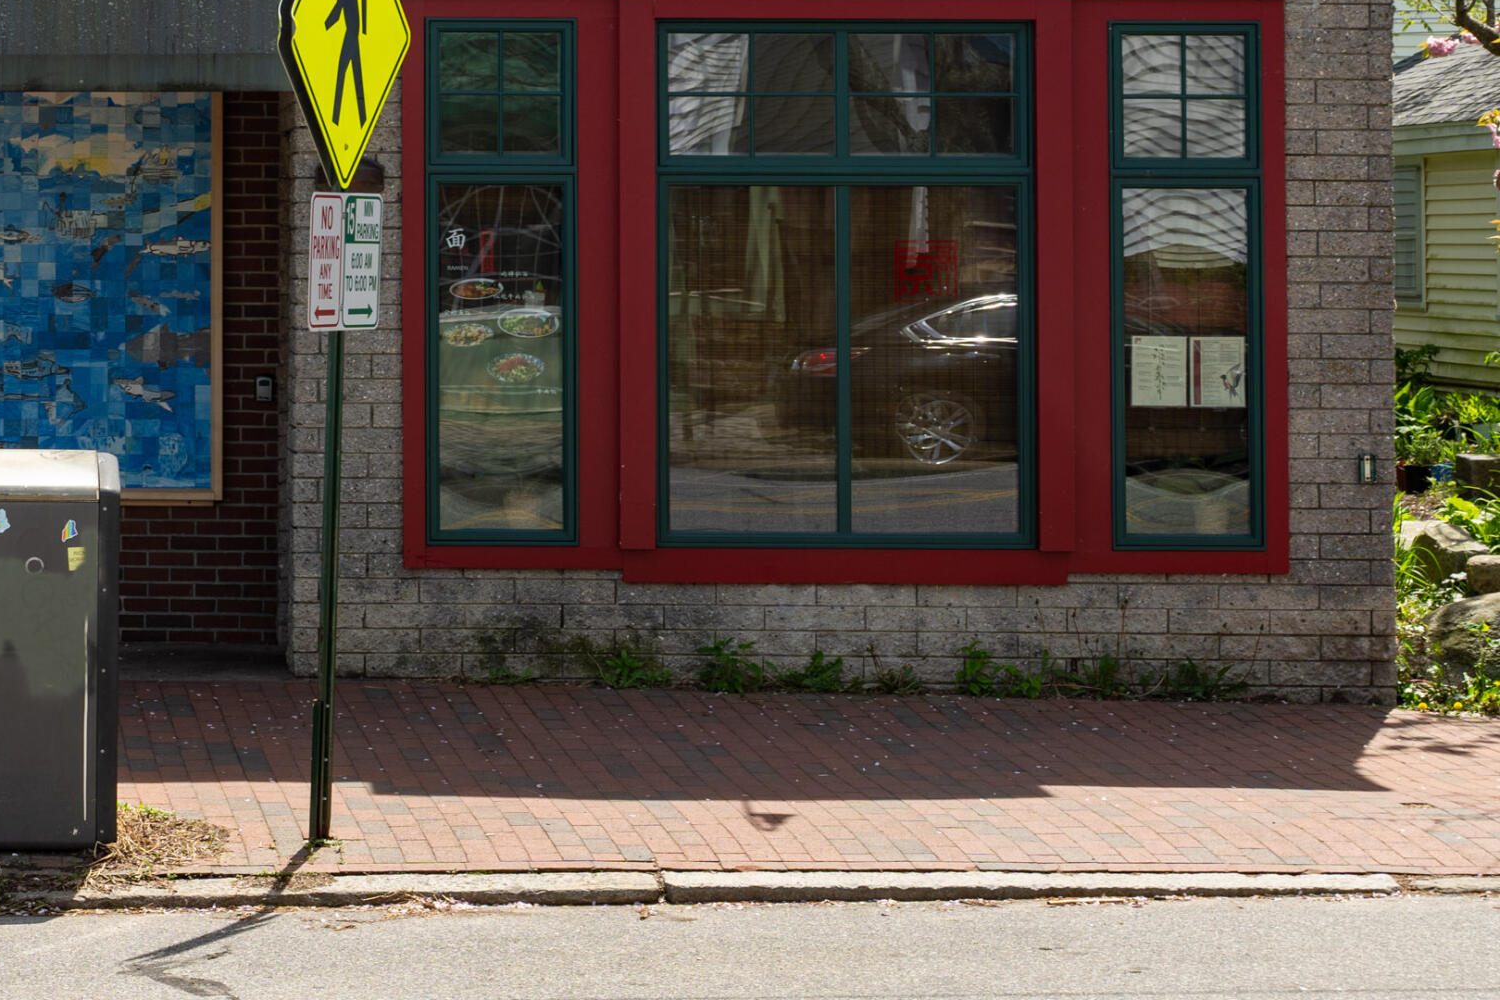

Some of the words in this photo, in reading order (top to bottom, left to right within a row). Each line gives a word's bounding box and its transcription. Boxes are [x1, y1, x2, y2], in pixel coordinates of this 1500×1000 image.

[321, 205, 333, 230] NO
[364, 201, 374, 217] MIN
[346, 202, 355, 235] 15
[357, 223, 379, 240] PARKING
[446, 228, 466, 249] 面
[313, 235, 340, 260] PARKING
[351, 253, 363, 269] 6:00
[364, 253, 372, 268] AM
[319, 263, 333, 280] ANY
[318, 283, 332, 300] TIME
[346, 275, 353, 292] TO
[354, 275, 367, 292] 6:00
[368, 275, 377, 292] PM
